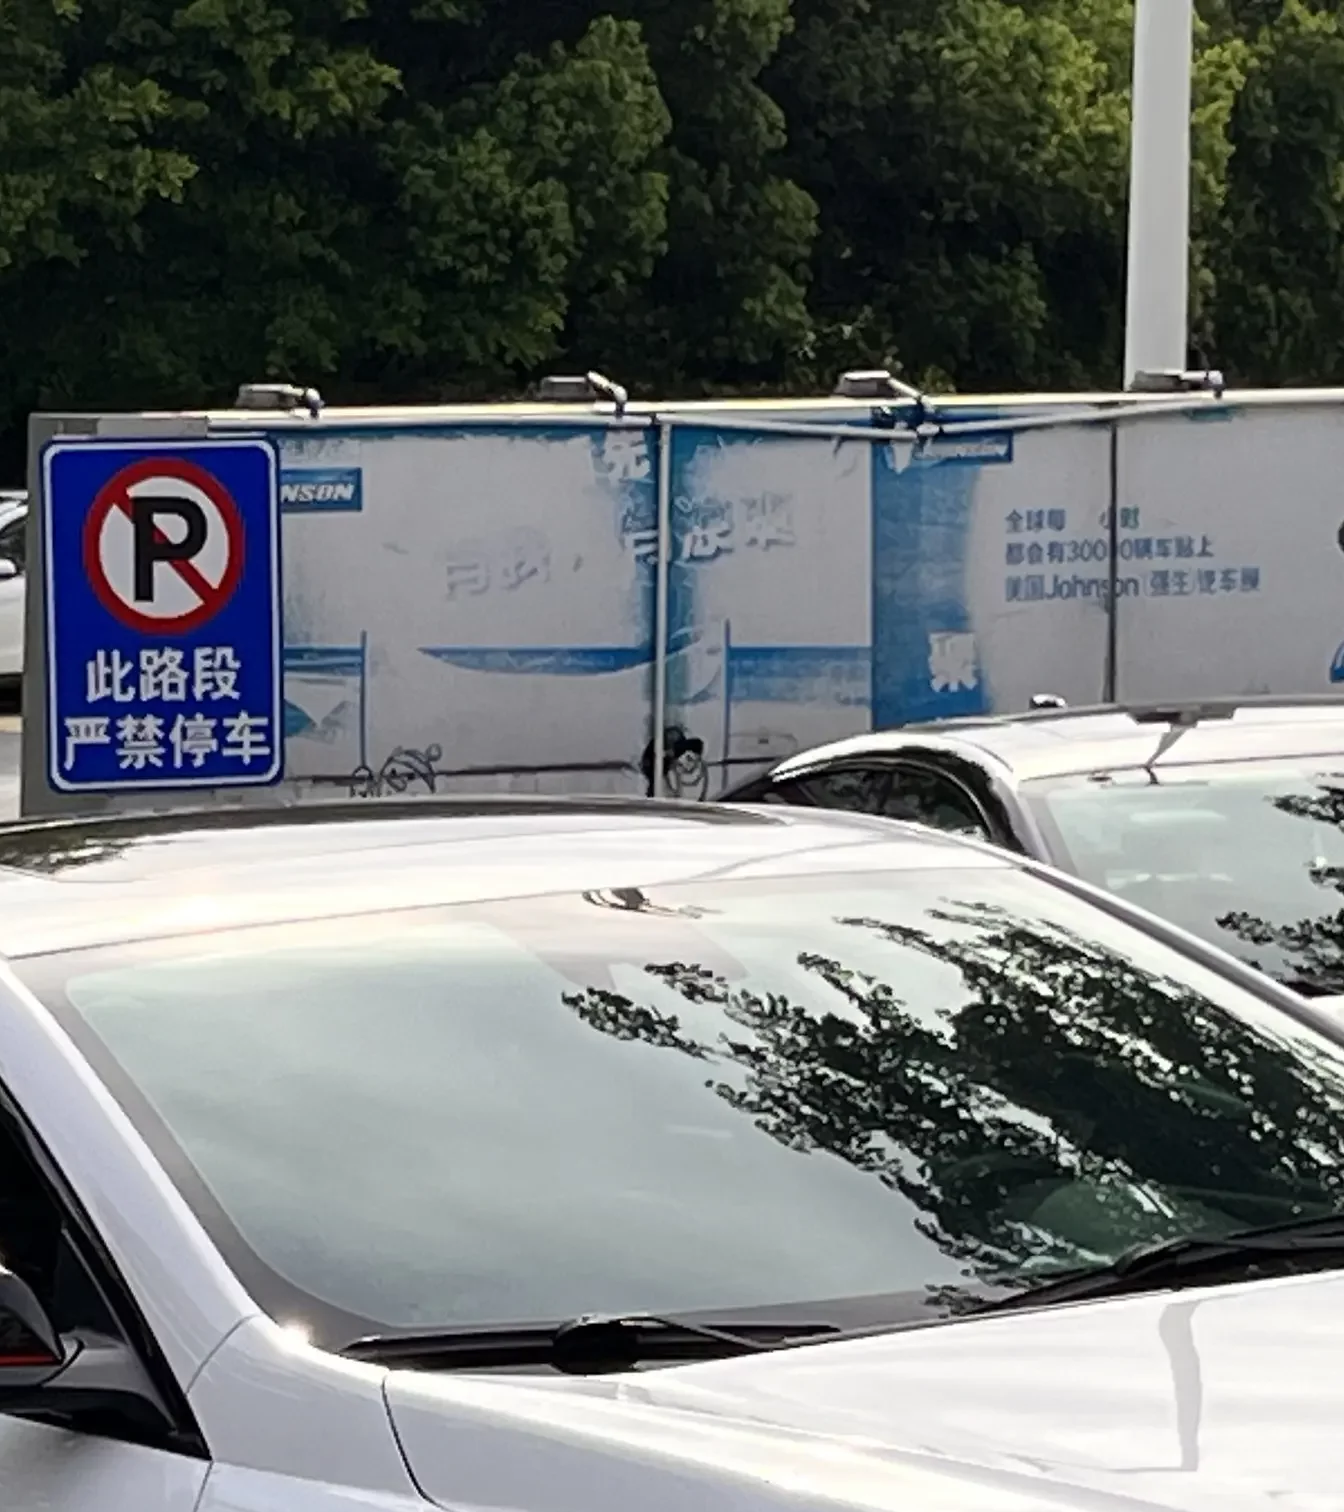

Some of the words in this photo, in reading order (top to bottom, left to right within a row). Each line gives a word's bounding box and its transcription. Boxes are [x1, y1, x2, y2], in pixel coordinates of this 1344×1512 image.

[86, 646, 242, 704] 此路段
[63, 709, 271, 772] 严禁停车
